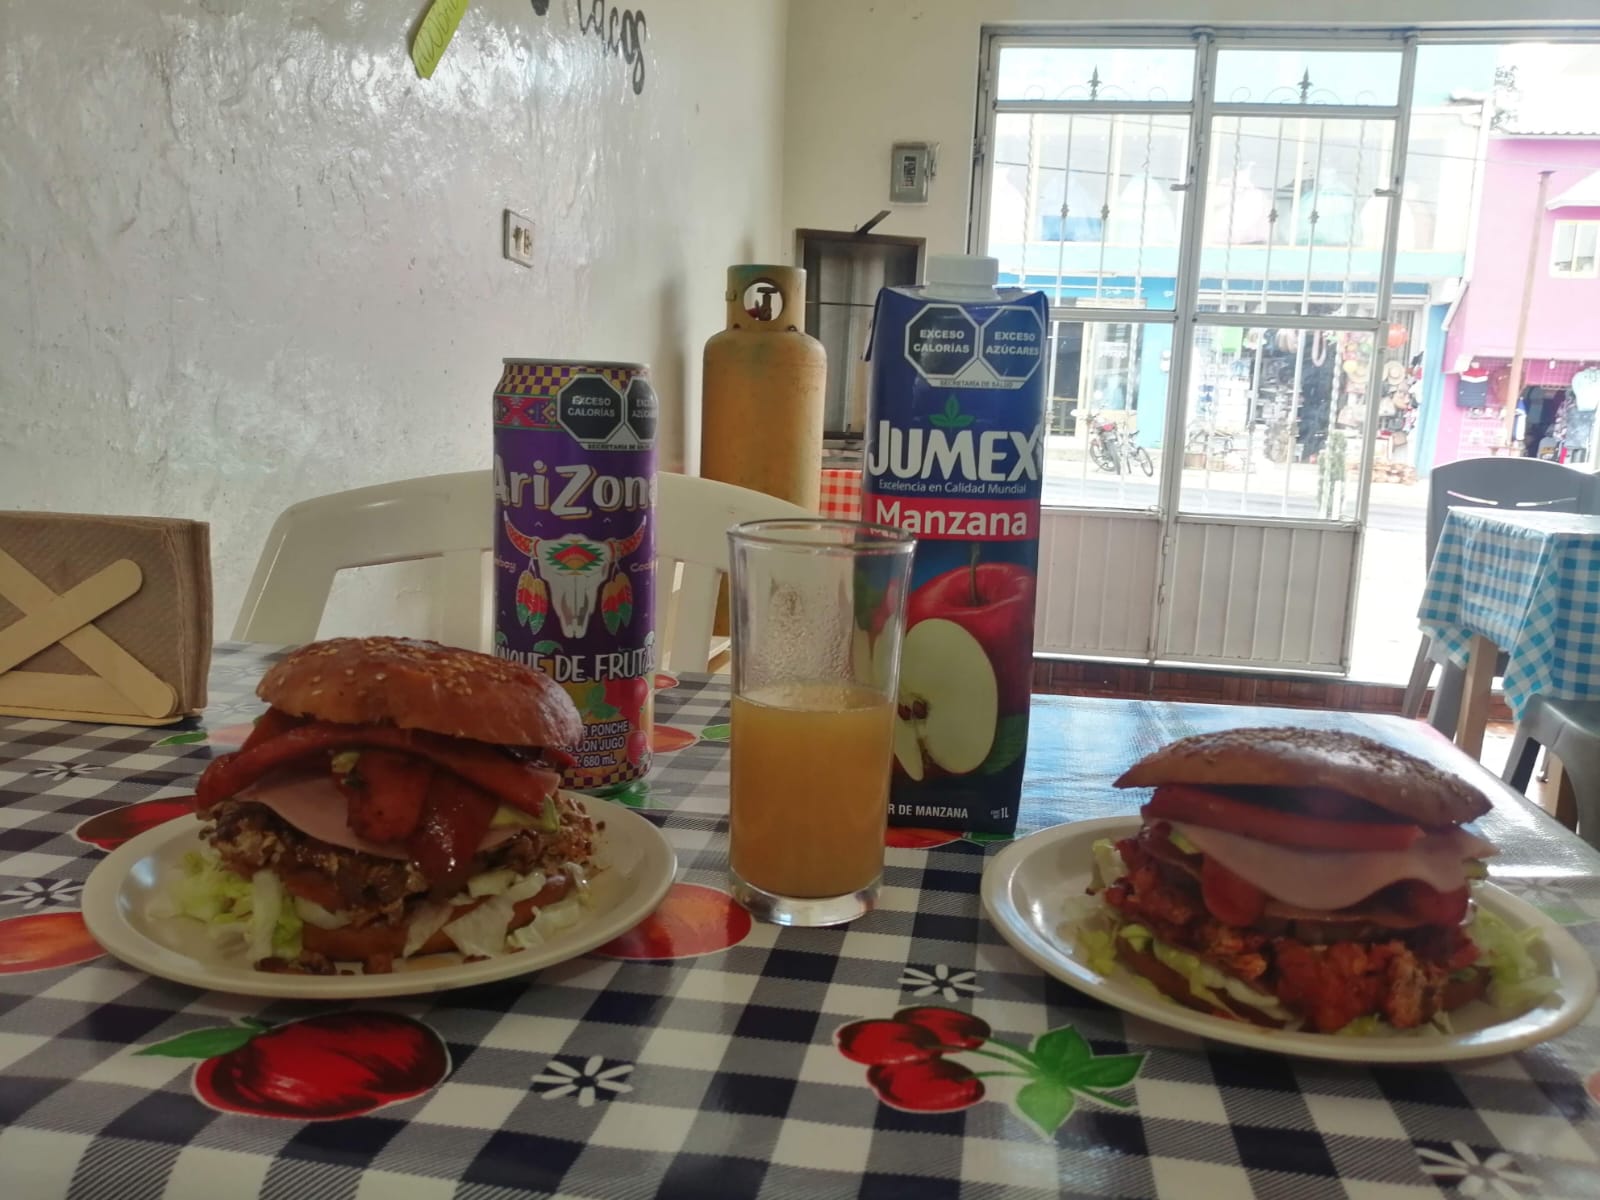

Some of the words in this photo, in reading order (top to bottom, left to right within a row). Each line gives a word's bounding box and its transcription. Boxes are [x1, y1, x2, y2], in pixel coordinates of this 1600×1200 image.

[920, 329, 965, 339] EXCESO
[994, 331, 1036, 342] EXCESO
[913, 342, 970, 353] CALORÍAS
[985, 344, 1039, 356] AZÚCARES
[572, 395, 612, 407] EXCESO
[567, 406, 615, 418] CALORÍAS
[868, 420, 1042, 482] JUMEX
[494, 453, 656, 520] AriZon
[879, 479, 926, 492] Excelencia
[928, 484, 942, 492] en
[944, 482, 985, 494] Calidad
[987, 484, 1026, 494] Mundial
[876, 499, 1027, 536] Manzana
[554, 654, 586, 682] DE
[591, 720, 629, 737] PONCHE
[599, 736, 625, 750] JUGO
[583, 755, 600, 767] 680
[898, 804, 912, 815] DE
[915, 806, 969, 818] MANZANA
